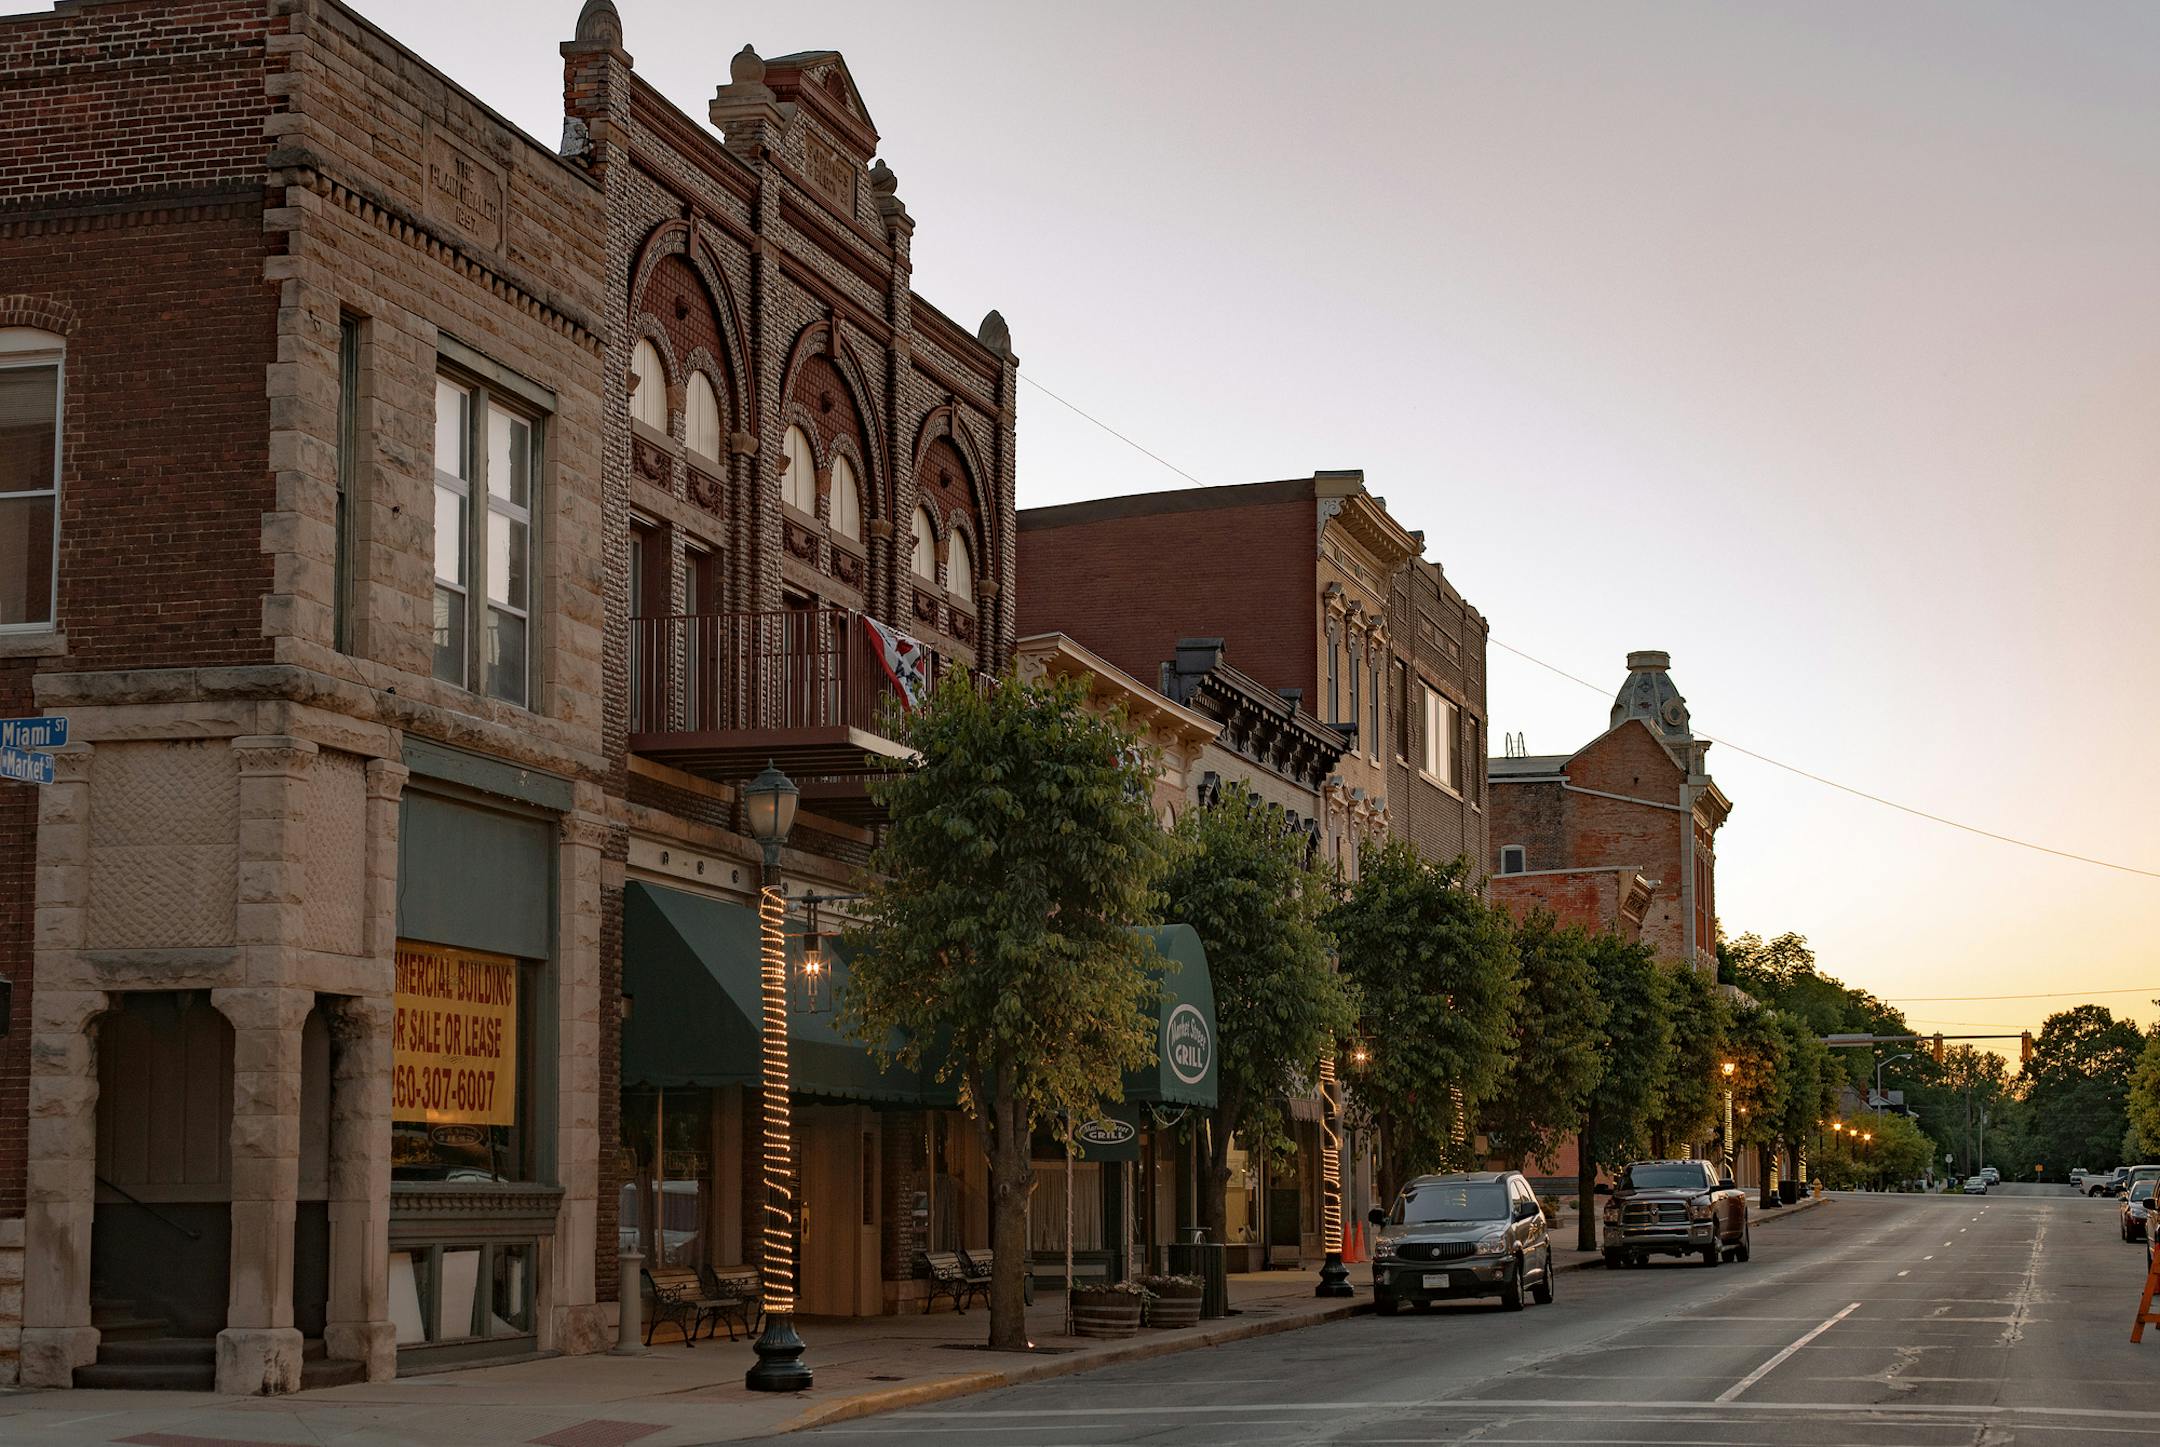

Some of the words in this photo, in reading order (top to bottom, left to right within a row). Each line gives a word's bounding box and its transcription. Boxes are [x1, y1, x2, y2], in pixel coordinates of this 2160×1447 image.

[430, 163, 458, 200] PLAIN
[456, 157, 474, 185] THE
[2, 720, 51, 746] Miami
[55, 719, 66, 732] ST
[7, 750, 44, 780] Market
[45, 756, 53, 769] ST
[395, 951, 453, 1000] MERCIAL
[458, 959, 512, 1006] BUILDING
[393, 1008, 406, 1051] R
[409, 1008, 441, 1053] SALE
[445, 1012, 461, 1056] OR
[465, 1015, 502, 1058] LEASE
[1175, 1044, 1203, 1069] GRILL
[1088, 1130, 1125, 1140] GRILL
